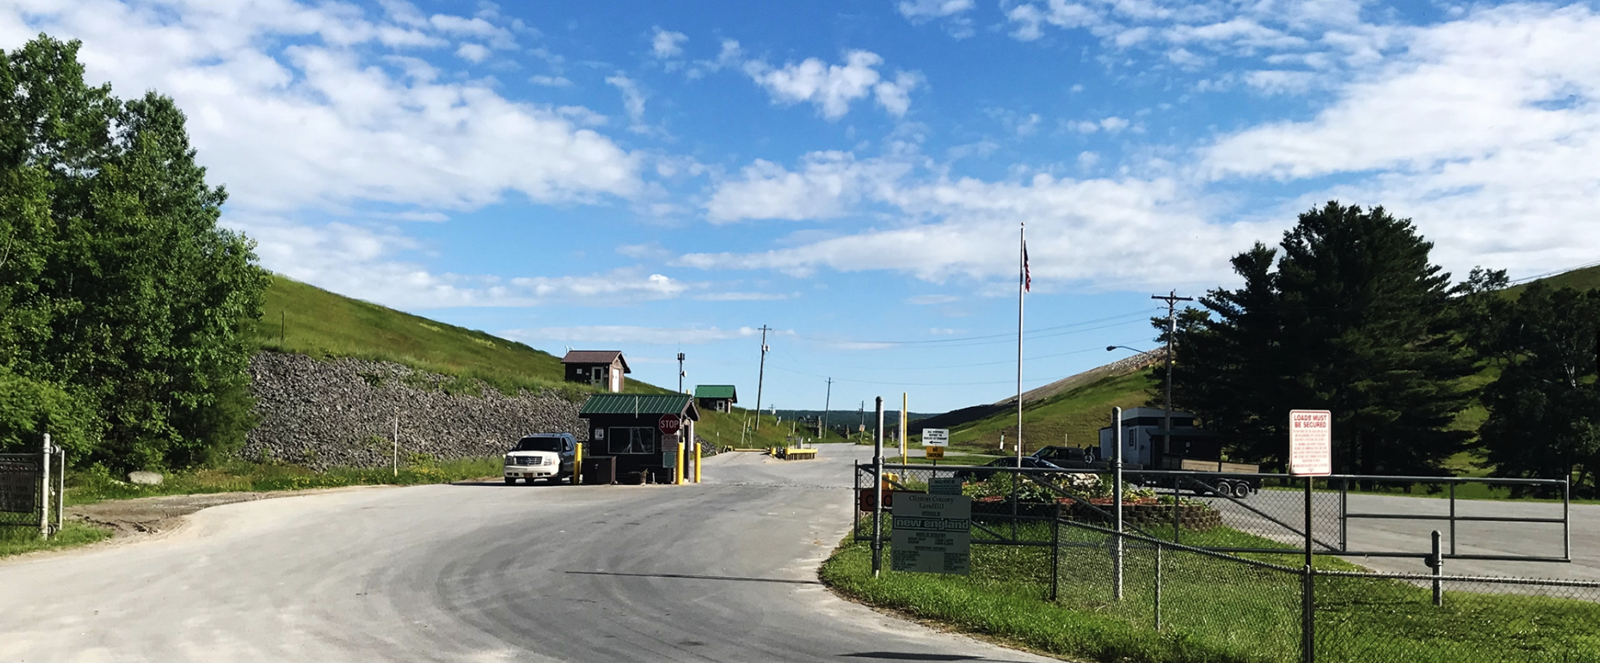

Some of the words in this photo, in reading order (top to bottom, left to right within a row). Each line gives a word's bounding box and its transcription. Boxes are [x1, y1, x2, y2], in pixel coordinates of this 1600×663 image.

[660, 420, 679, 428] STOP
[932, 496, 955, 504] County
[896, 519, 922, 527] new
[923, 518, 969, 530] england
